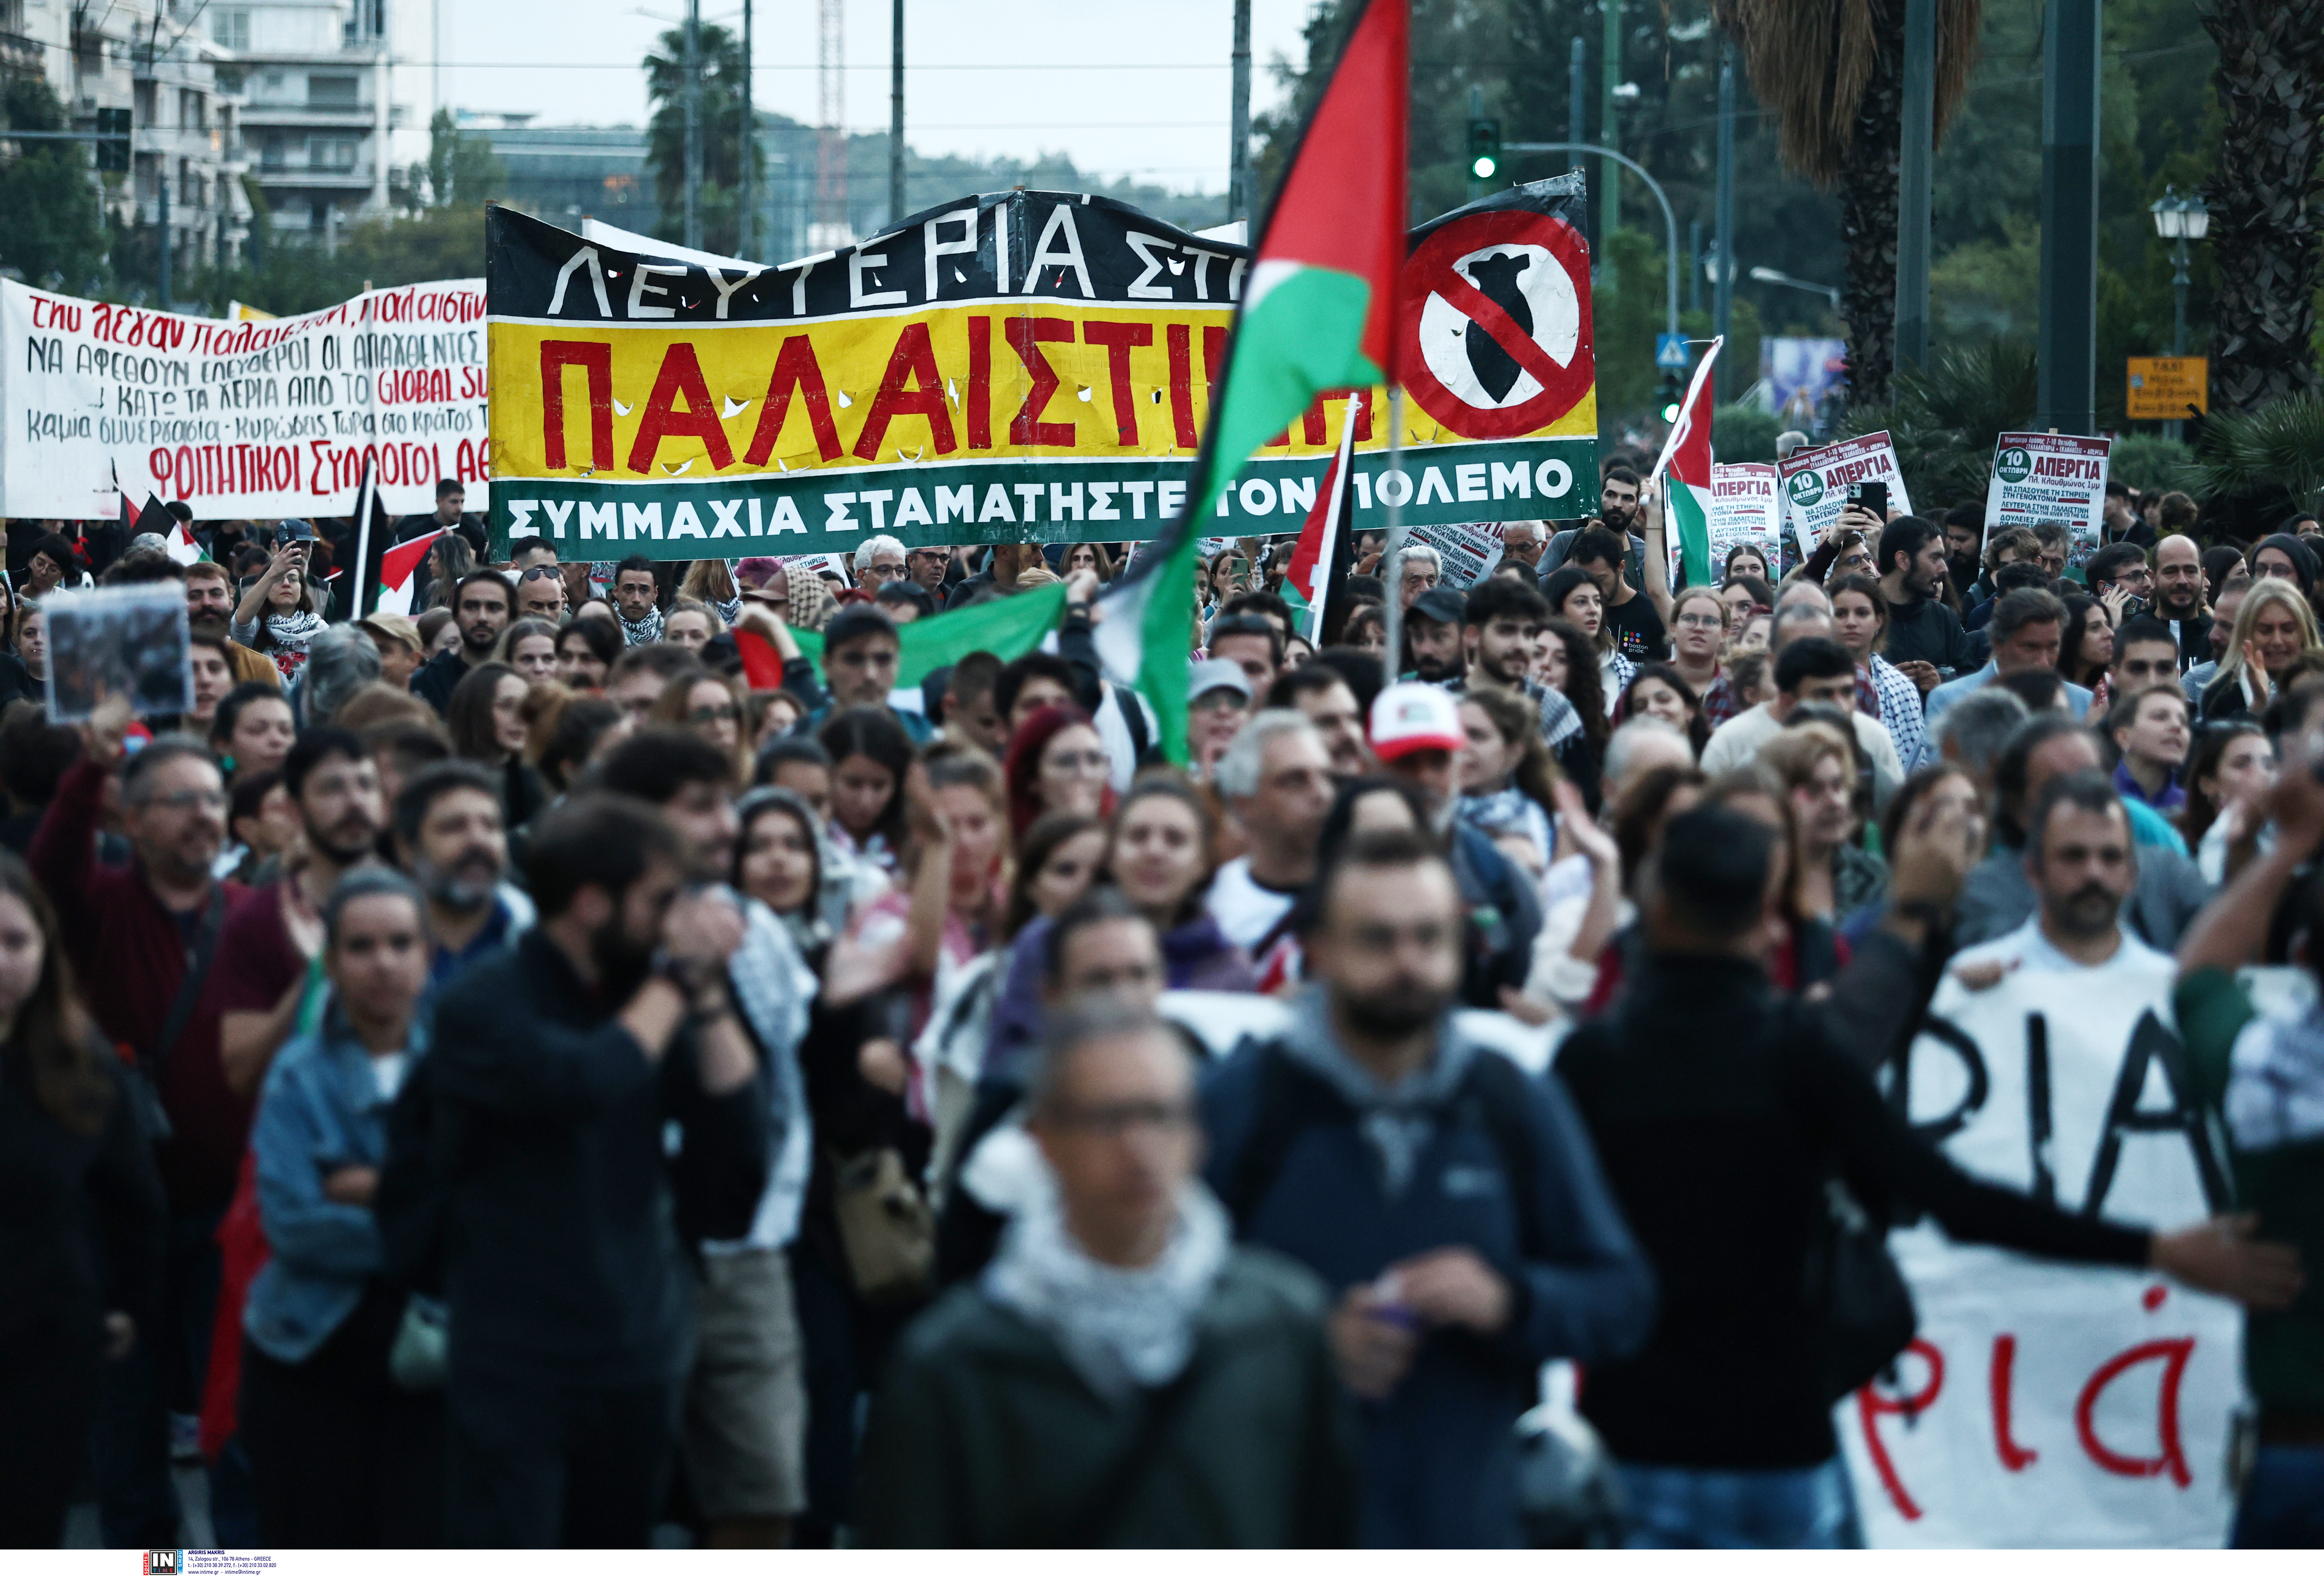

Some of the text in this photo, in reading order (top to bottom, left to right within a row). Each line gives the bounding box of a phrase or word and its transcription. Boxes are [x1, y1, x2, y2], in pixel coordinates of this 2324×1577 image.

[28, 331, 483, 387] ΝΑ ΑΦΕΘΟΥΝ ΕΛΕΥΘΕΡΟΙ ΟΙ ΑΠΑΧΘΕΝΤΕΣ
[118, 366, 488, 417] ΚΑΤΩ ΤΑ ΧΕΡΙΑ ΑΠΟ ΤΟ GLOBAL SU
[2006, 451, 2023, 466] 10
[149, 437, 489, 500] ΦΟΙΤΗΤΙΚΟΙ ΣΥΛΛΟΓΟΙ ΑΘ
[1826, 454, 1893, 489] ΑΠΕΡΓΙΑ
[1999, 466, 2028, 475] ΟΚΤΩΒΡΗ
[2034, 456, 2100, 480] ΑΠΕΡΓΙΑ
[1793, 473, 1813, 491] 10
[2042, 477, 2085, 488] Κλαυθμώνος
[508, 459, 1573, 540] ΣΥΜΜΑΧΙΑ ΣΤΑΜΑΤΗΣΤΕ ΤΟΝ ΠΟΛΕΜΟ
[1793, 485, 1822, 501] ΟΚΤΩΒΡΗ
[2014, 486, 2049, 496] ΣΠΑΣΟΥΜΕ
[2061, 490, 2090, 499] ΣΤΗΡΙΞΗ
[2016, 493, 2057, 502] ΓΕΝΟΚΤΟΝΙΑ
[1807, 506, 1844, 522] ΣΤΗ ΓΕΝΟΚΤ
[2001, 501, 2031, 509] ΛΕΥΤΕΡΙΑ
[2052, 506, 2089, 514] ΠΑΛΑΙΣΤΙΝΗ
[2000, 514, 2035, 523] ΔΟΥΛΕΙΕΣ
[1465, 537, 1490, 555] ΣΤΗΡΙΞΗ
[799, 555, 826, 568] ΣΤΗΡΙΞΗ
[1452, 547, 1484, 569] ΠΑΛΑΙΣΤΙΝΗ
[1900, 1008, 2237, 1218] ΡΙΑ
[1859, 1283, 2196, 1520] ριά
